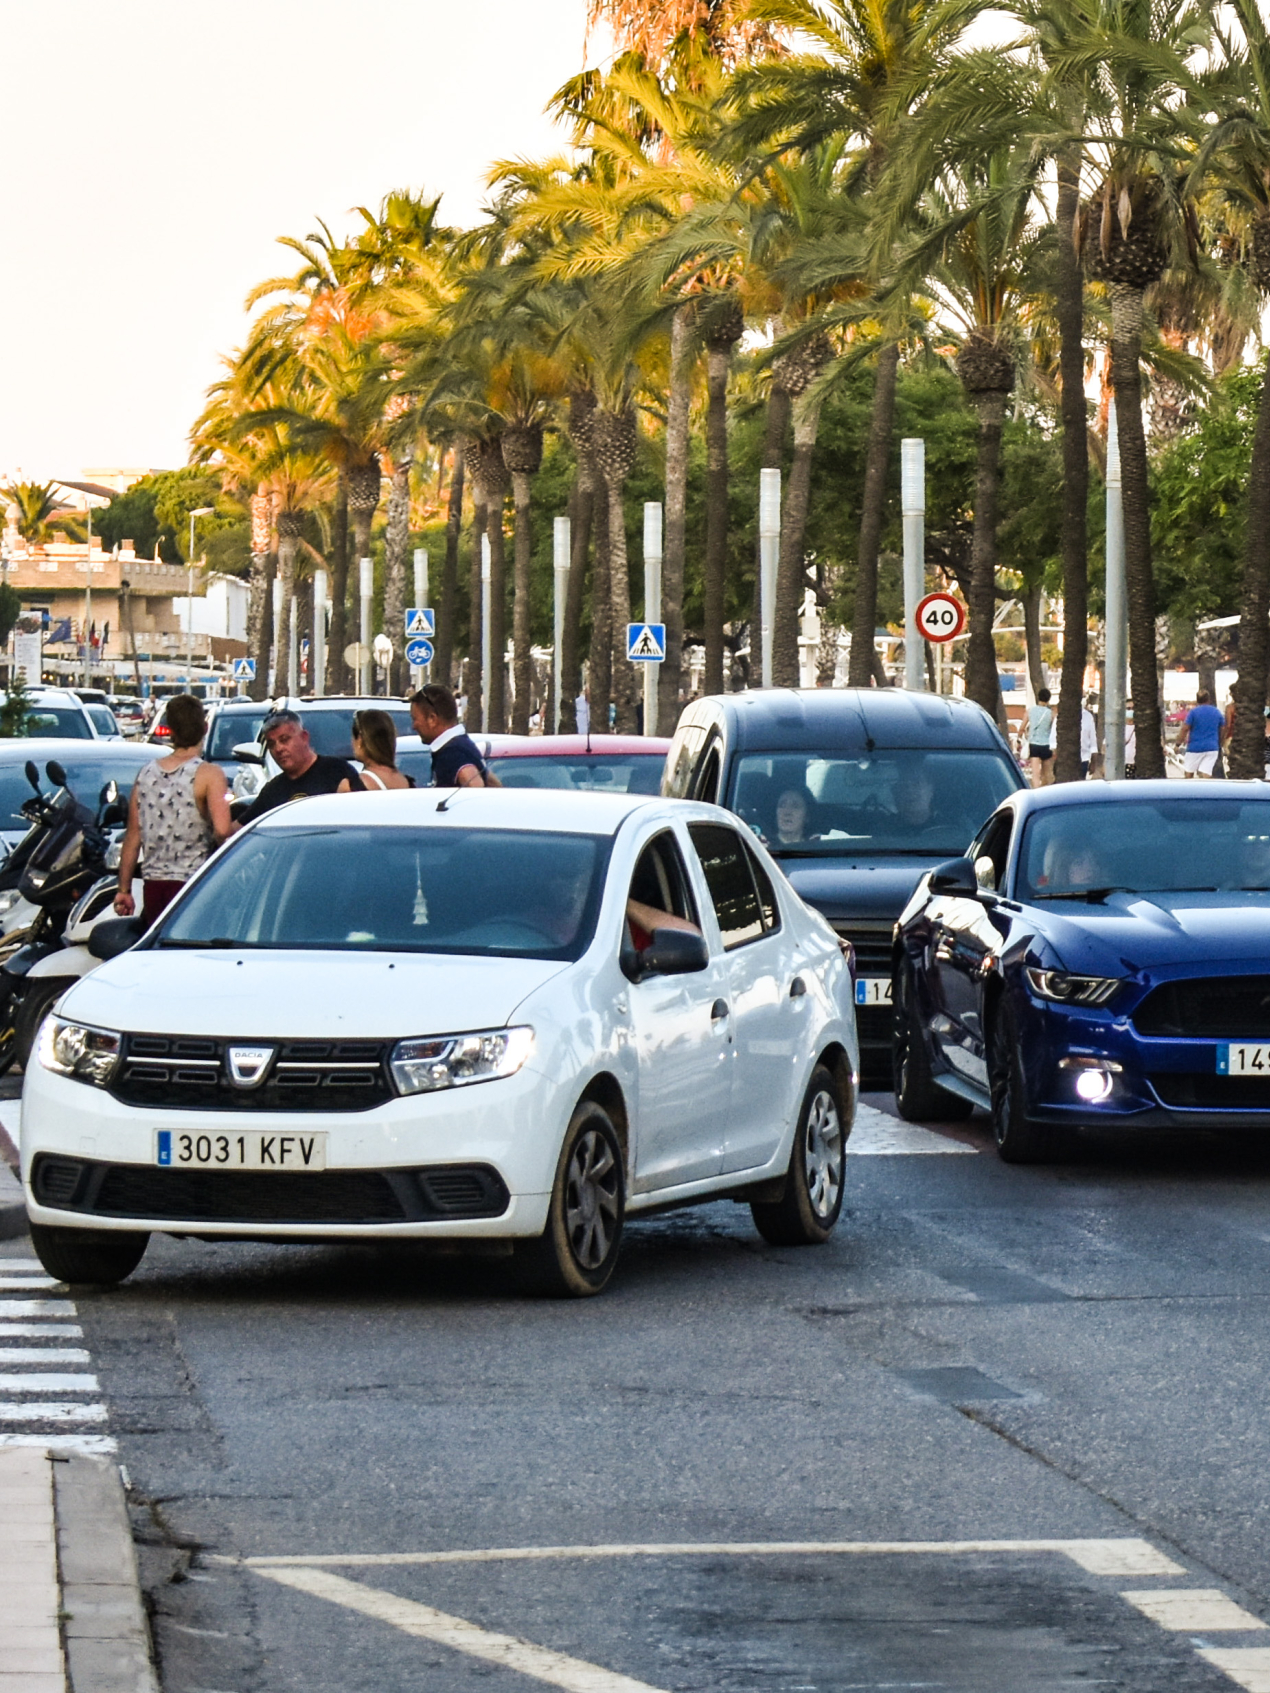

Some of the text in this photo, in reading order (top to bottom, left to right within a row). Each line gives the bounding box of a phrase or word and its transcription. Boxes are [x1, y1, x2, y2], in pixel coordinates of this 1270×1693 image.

[926, 610, 954, 626] 40
[161, 1151, 168, 1160] E
[178, 1135, 315, 1165] 3031 KFV
